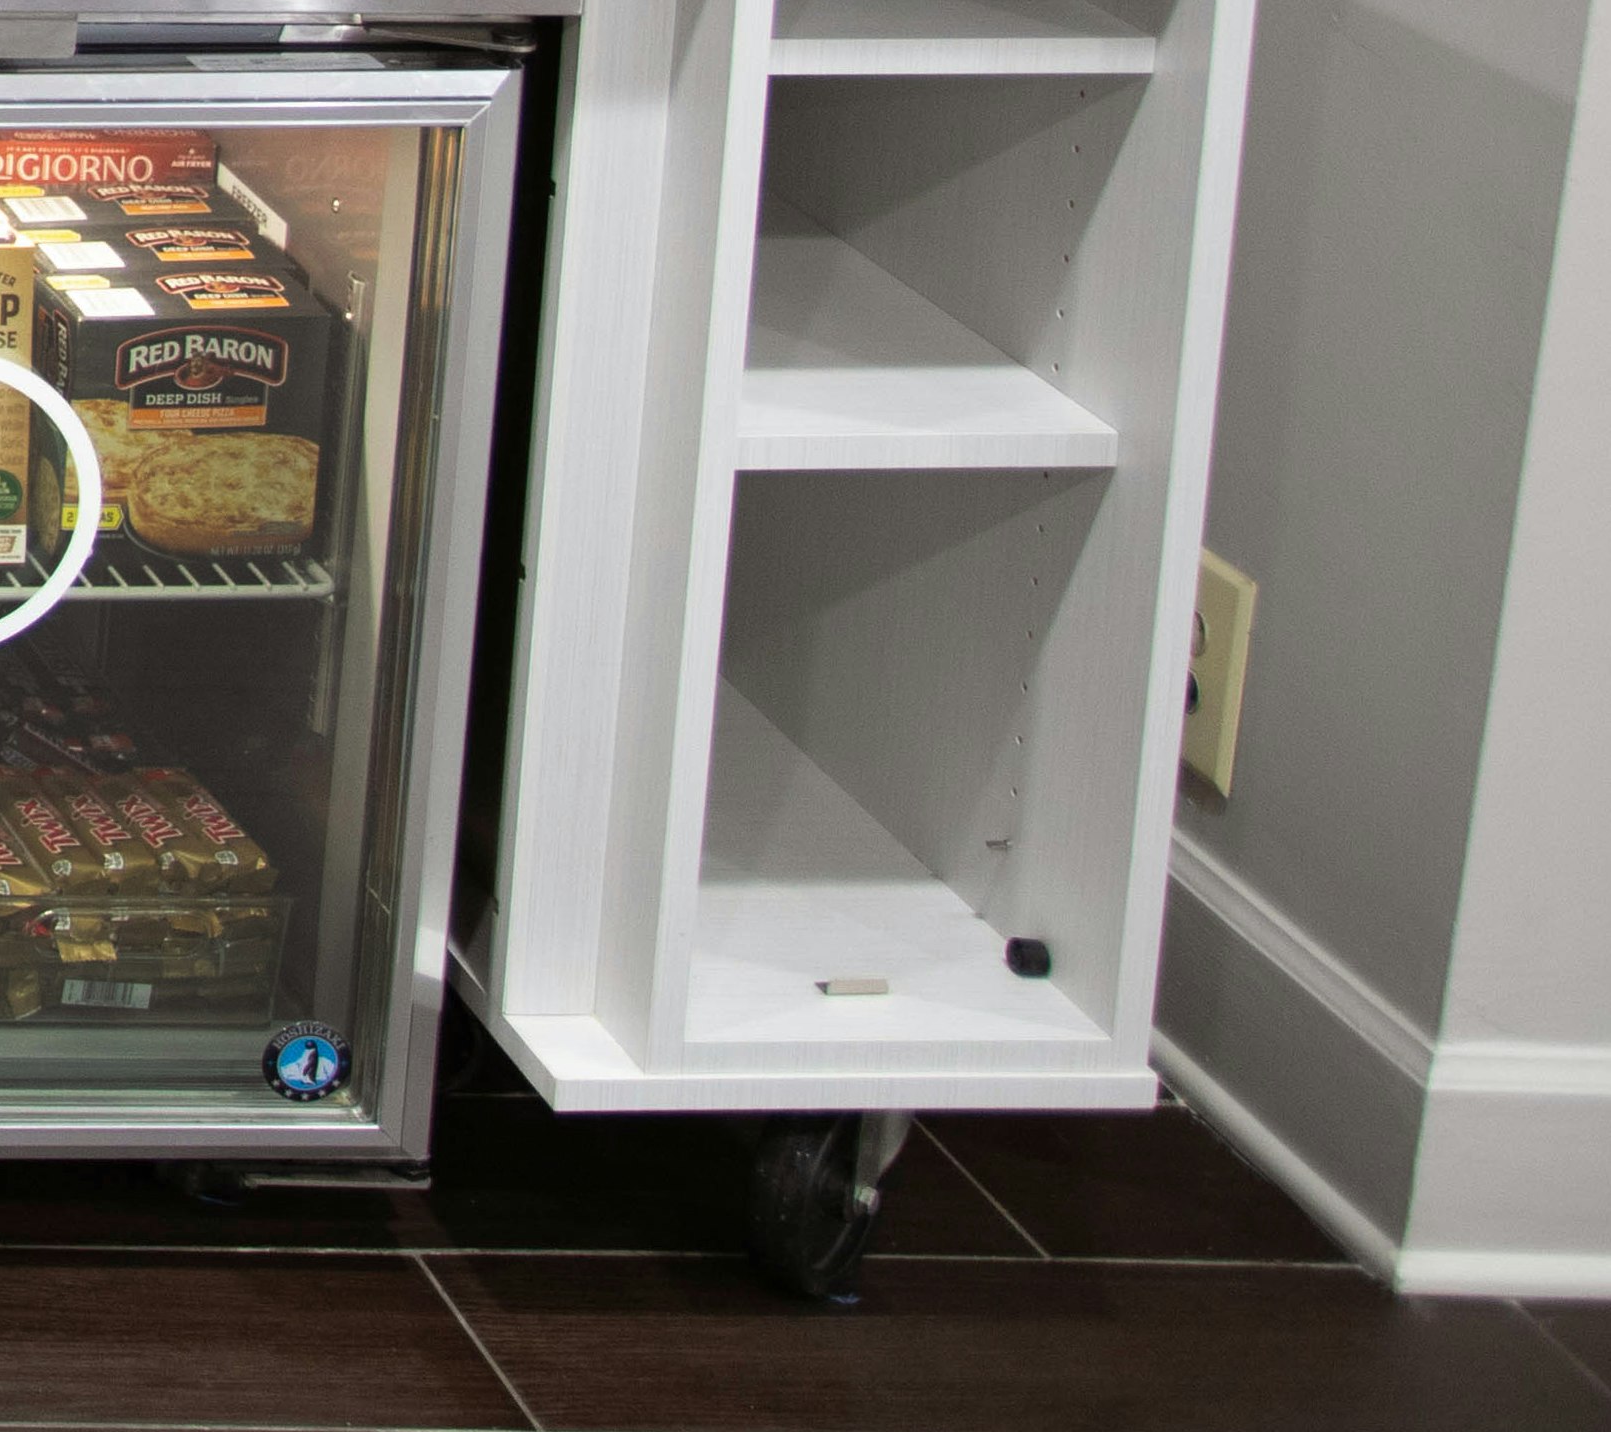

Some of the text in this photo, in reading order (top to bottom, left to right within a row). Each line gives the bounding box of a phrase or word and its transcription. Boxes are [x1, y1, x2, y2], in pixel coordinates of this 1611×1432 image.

[166, 273, 271, 290] RED BARON
[129, 334, 275, 373] RED BARON
